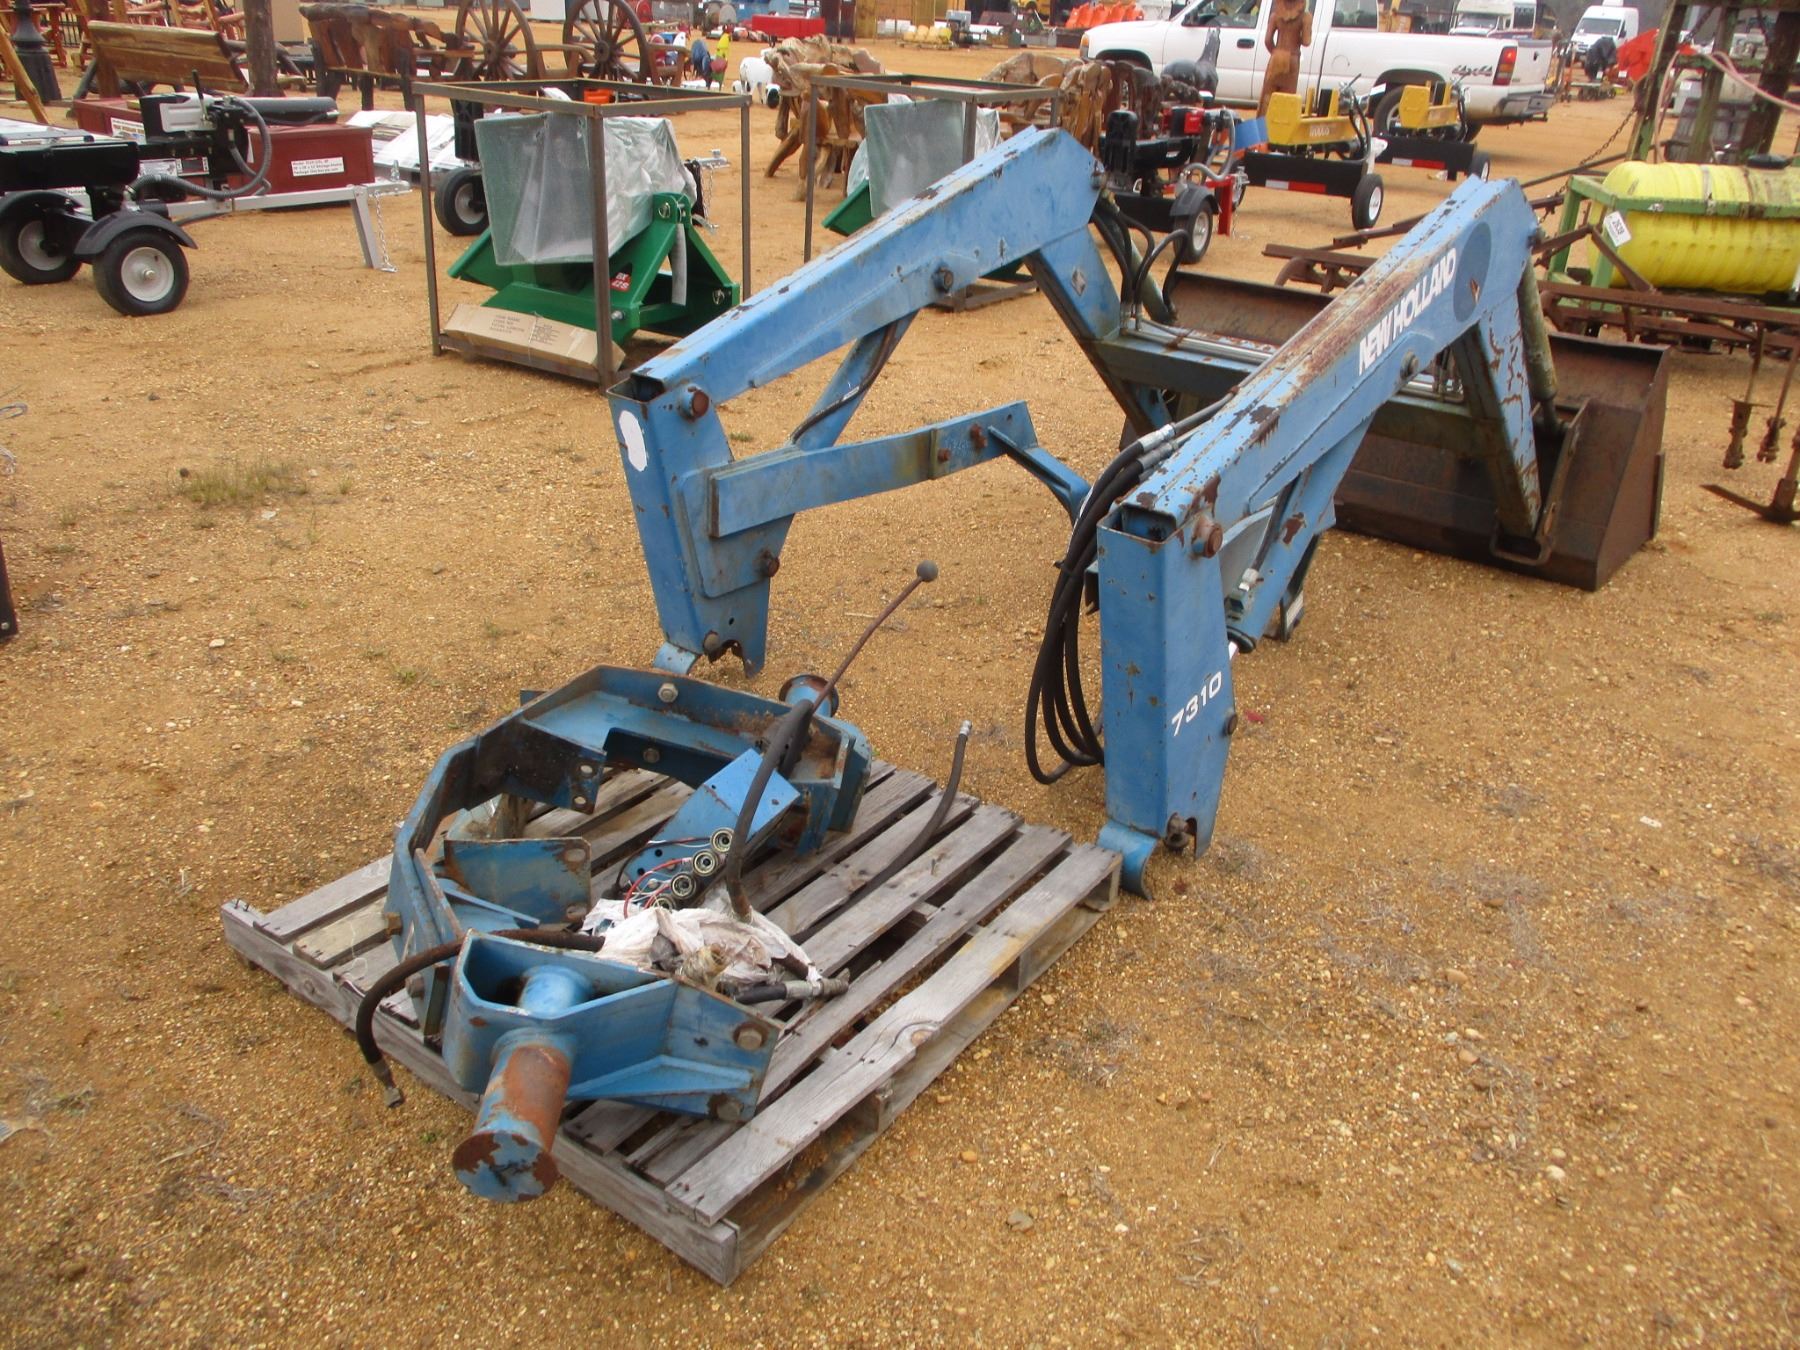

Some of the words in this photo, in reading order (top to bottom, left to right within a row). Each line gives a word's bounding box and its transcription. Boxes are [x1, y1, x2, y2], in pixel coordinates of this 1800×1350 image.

[1359, 310, 1394, 376] NEW
[1393, 247, 1457, 341] HOLLAND
[1171, 670, 1222, 737] 7310
